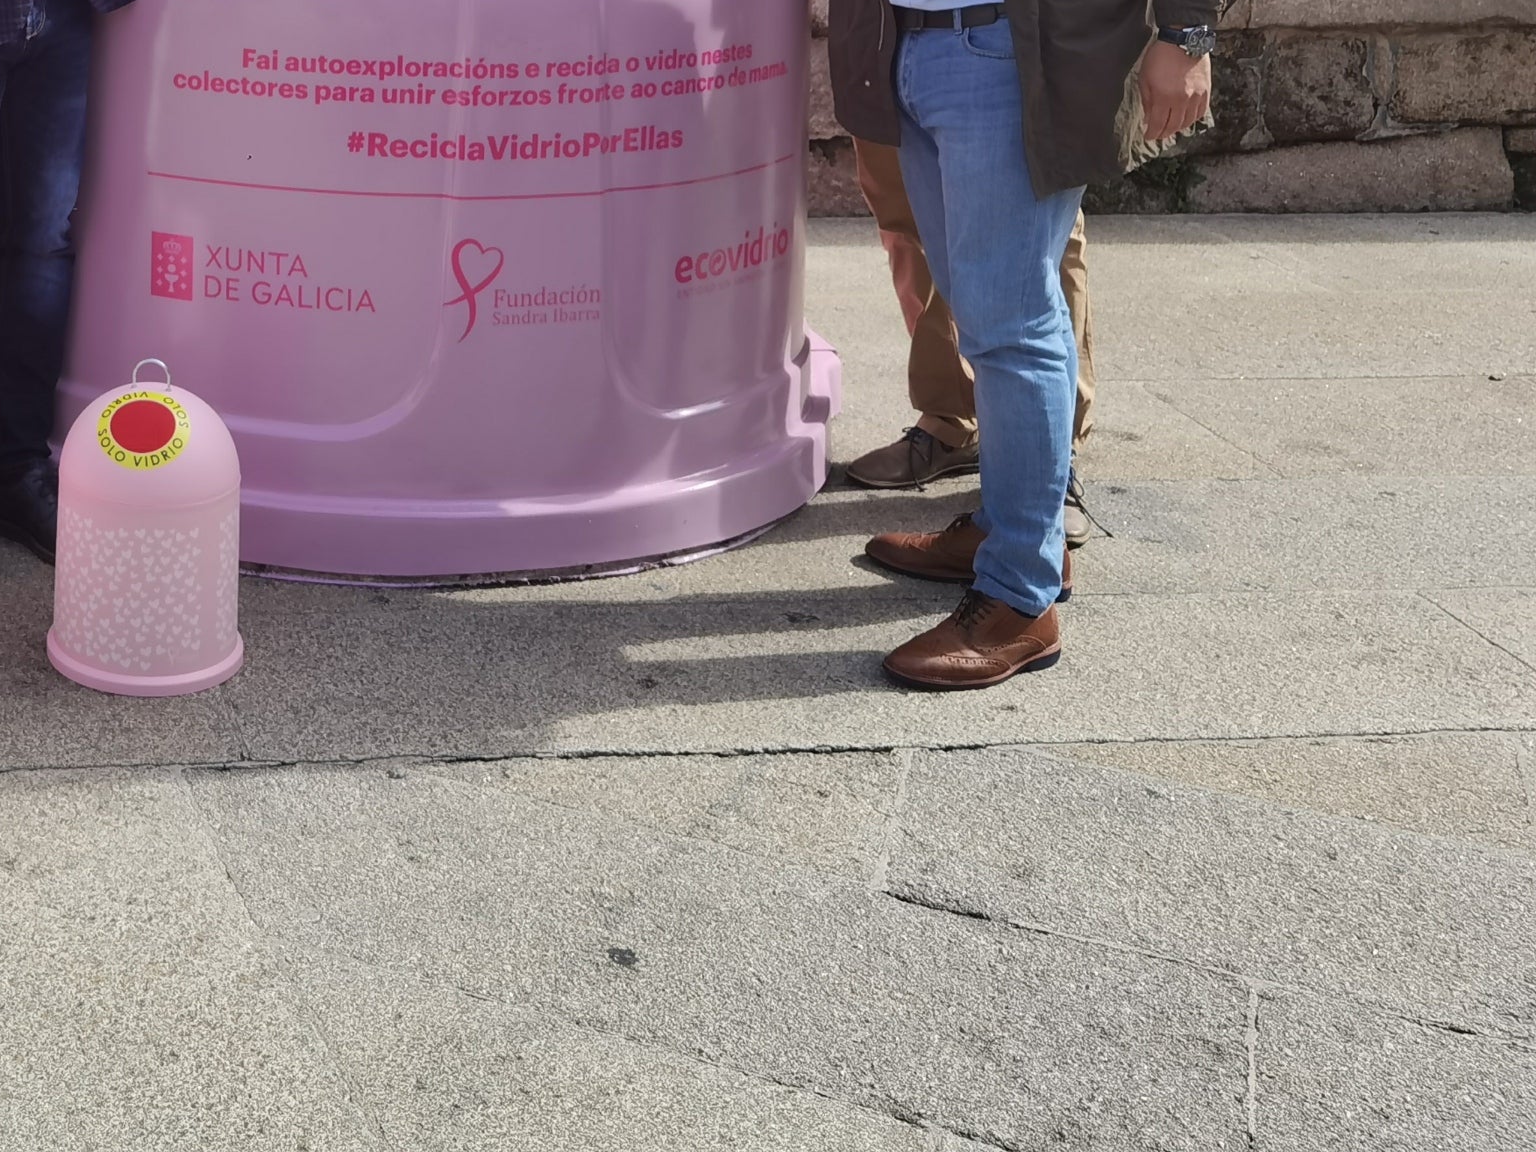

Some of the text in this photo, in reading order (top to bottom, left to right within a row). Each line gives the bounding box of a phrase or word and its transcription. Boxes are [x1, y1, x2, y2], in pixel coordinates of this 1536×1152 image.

[242, 43, 753, 81] Fai autoexploracións e recicla o vidro nestes
[173, 70, 309, 100] colectores
[315, 84, 375, 105] para
[381, 83, 436, 105] unir
[441, 83, 552, 107] esforzos
[558, 82, 624, 105] fronte
[630, 81, 657, 99] ao
[661, 70, 725, 97] cancro
[728, 66, 747, 89] de
[347, 125, 684, 162] #ReciclaVidrioPorEllas
[206, 244, 308, 278] XUNTA
[674, 221, 789, 284] ecovidrio
[204, 274, 376, 313] DE GALICIA
[493, 284, 602, 308] Fundación
[492, 308, 600, 326] Sandra Ibarra
[98, 429, 183, 467] SOLO VIDRIO
